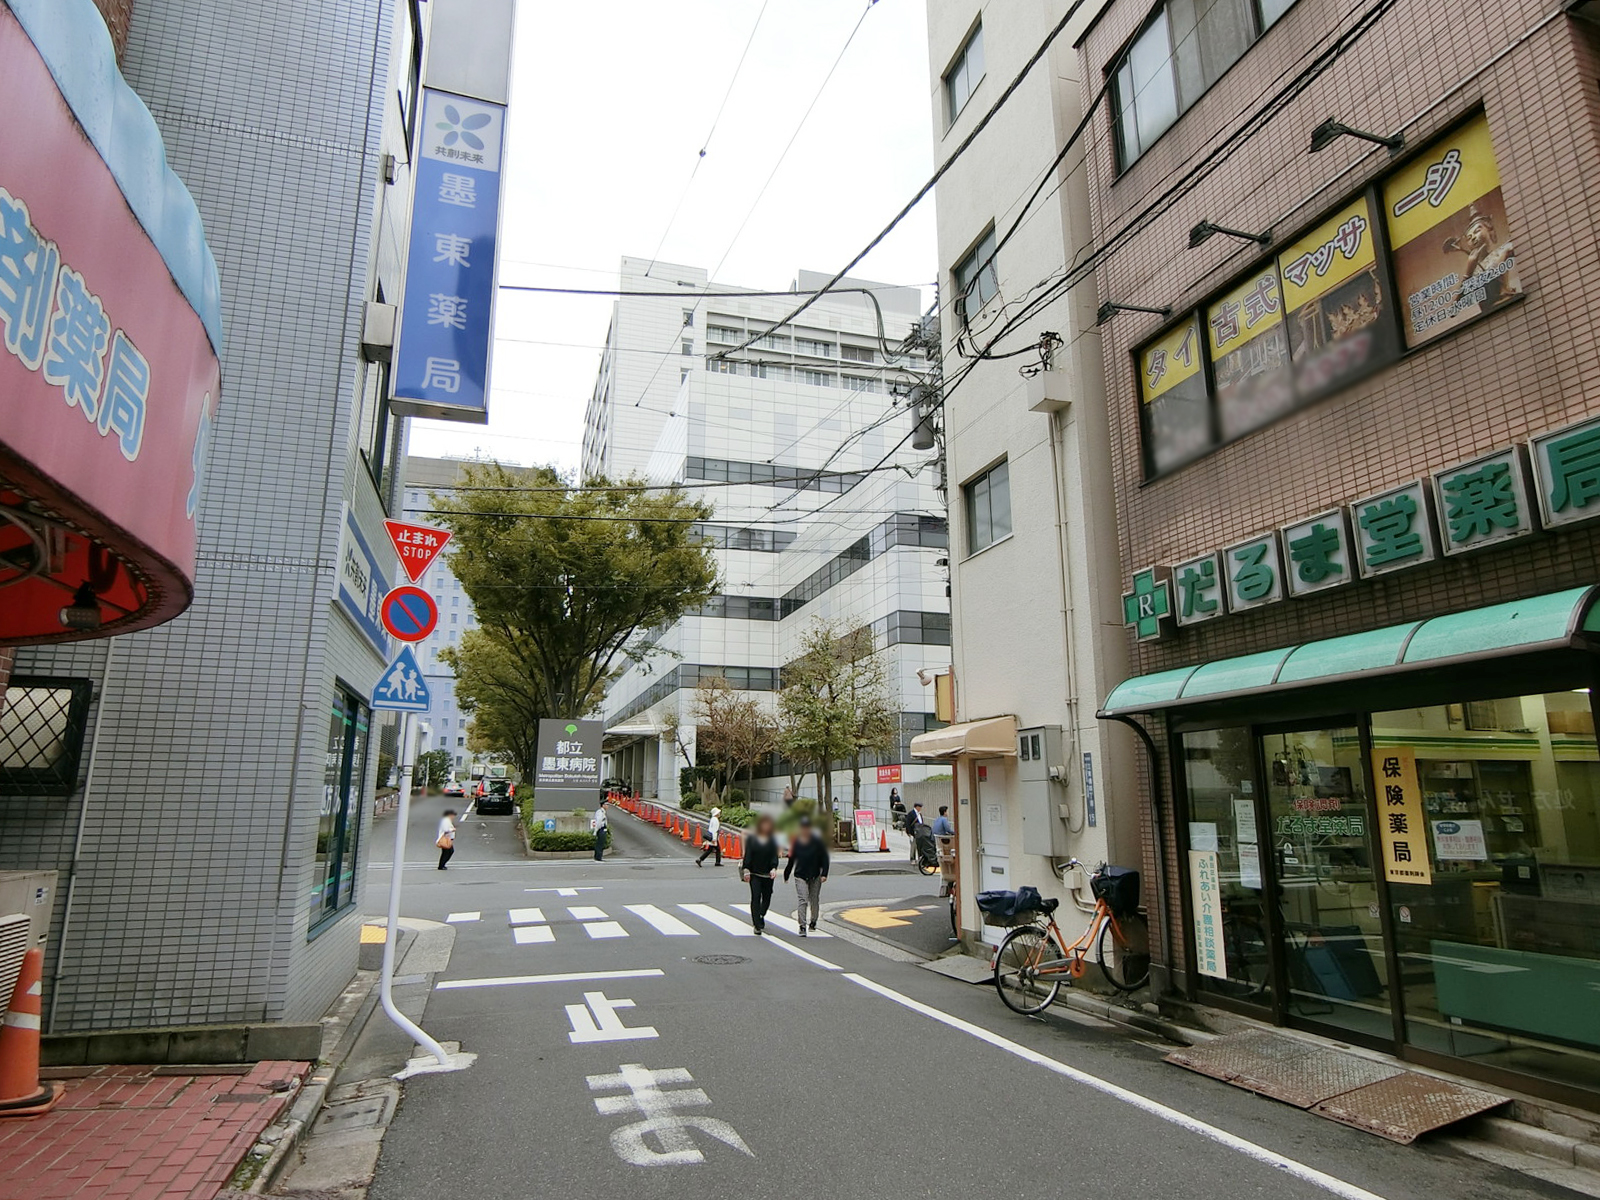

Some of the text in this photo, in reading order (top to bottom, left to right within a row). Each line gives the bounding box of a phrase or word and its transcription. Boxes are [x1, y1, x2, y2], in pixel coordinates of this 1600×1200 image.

[435, 145, 484, 164] 共創未来
[421, 172, 477, 393] 墨東薬局
[1178, 427, 1600, 617] だるま堂薬局
[397, 529, 438, 547] 止まれ
[403, 546, 432, 560] STOP
[1138, 594, 1154, 618] R
[556, 740, 583, 755] 都立
[542, 757, 597, 771] 墨東病院
[1293, 797, 1341, 811] 保険調剤
[1382, 757, 1411, 862] 保険薬局
[1276, 815, 1364, 836] だるま堂薬局
